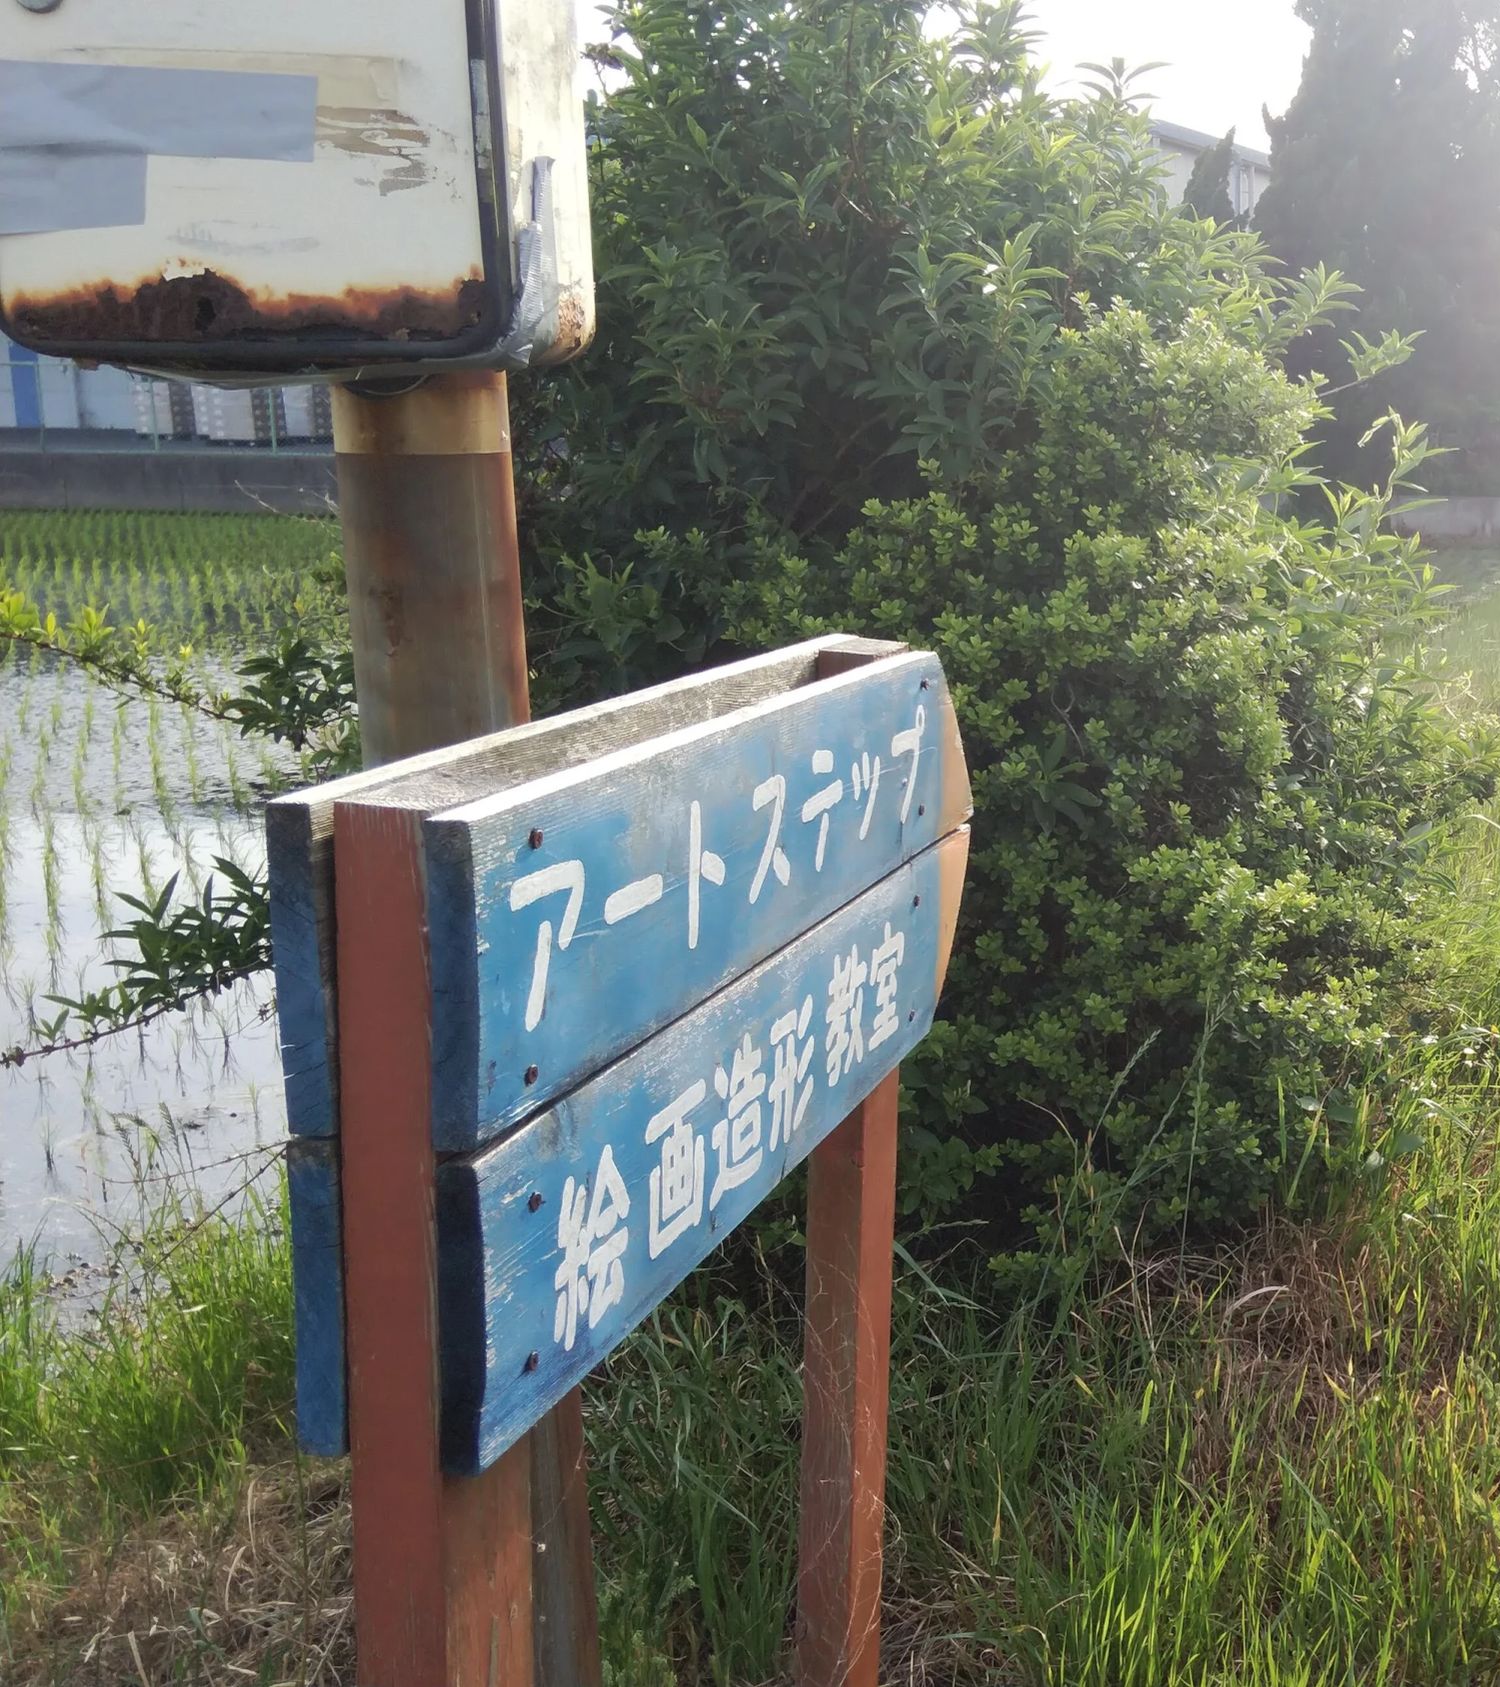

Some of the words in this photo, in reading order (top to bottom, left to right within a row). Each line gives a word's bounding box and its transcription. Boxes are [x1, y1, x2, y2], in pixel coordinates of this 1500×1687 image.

[509, 704, 925, 1033] アートステップ
[553, 921, 905, 1352] 絵画造形教室
